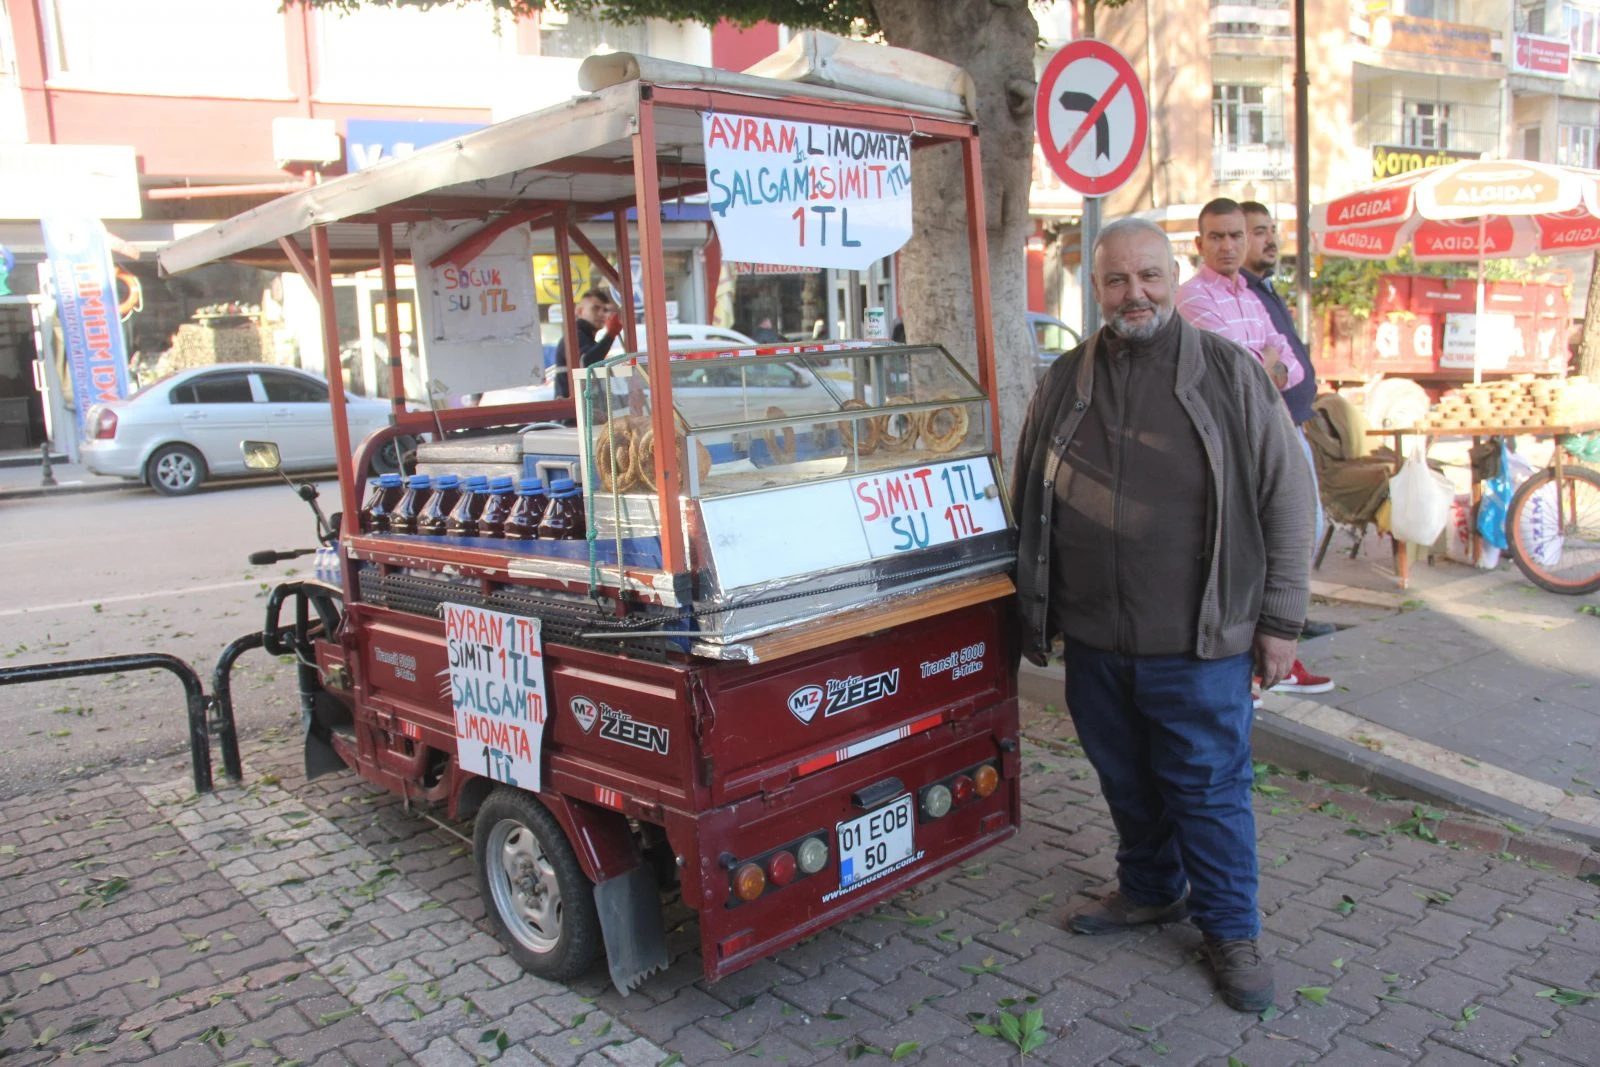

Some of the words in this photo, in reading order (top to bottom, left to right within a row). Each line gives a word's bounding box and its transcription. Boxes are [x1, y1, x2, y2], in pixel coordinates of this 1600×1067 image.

[708, 116, 796, 153] AYRAN
[1386, 152, 1423, 175] OTO
[448, 294, 471, 312] SU
[941, 464, 985, 504] 1TL
[890, 512, 930, 551] SU
[944, 504, 984, 540] 1TL
[446, 607, 503, 647] AYRAN
[505, 616, 542, 658] 1TL
[498, 648, 537, 688] 1TL
[920, 651, 959, 679] Transit
[960, 642, 985, 664] 5000
[573, 702, 594, 717] MZ
[793, 690, 819, 709] MZ
[824, 668, 900, 717] ZEEN
[599, 714, 669, 755] ZEEN
[842, 823, 861, 852] 01
[869, 803, 908, 841] EOB
[864, 841, 887, 871] 50
[843, 874, 853, 885] TR
